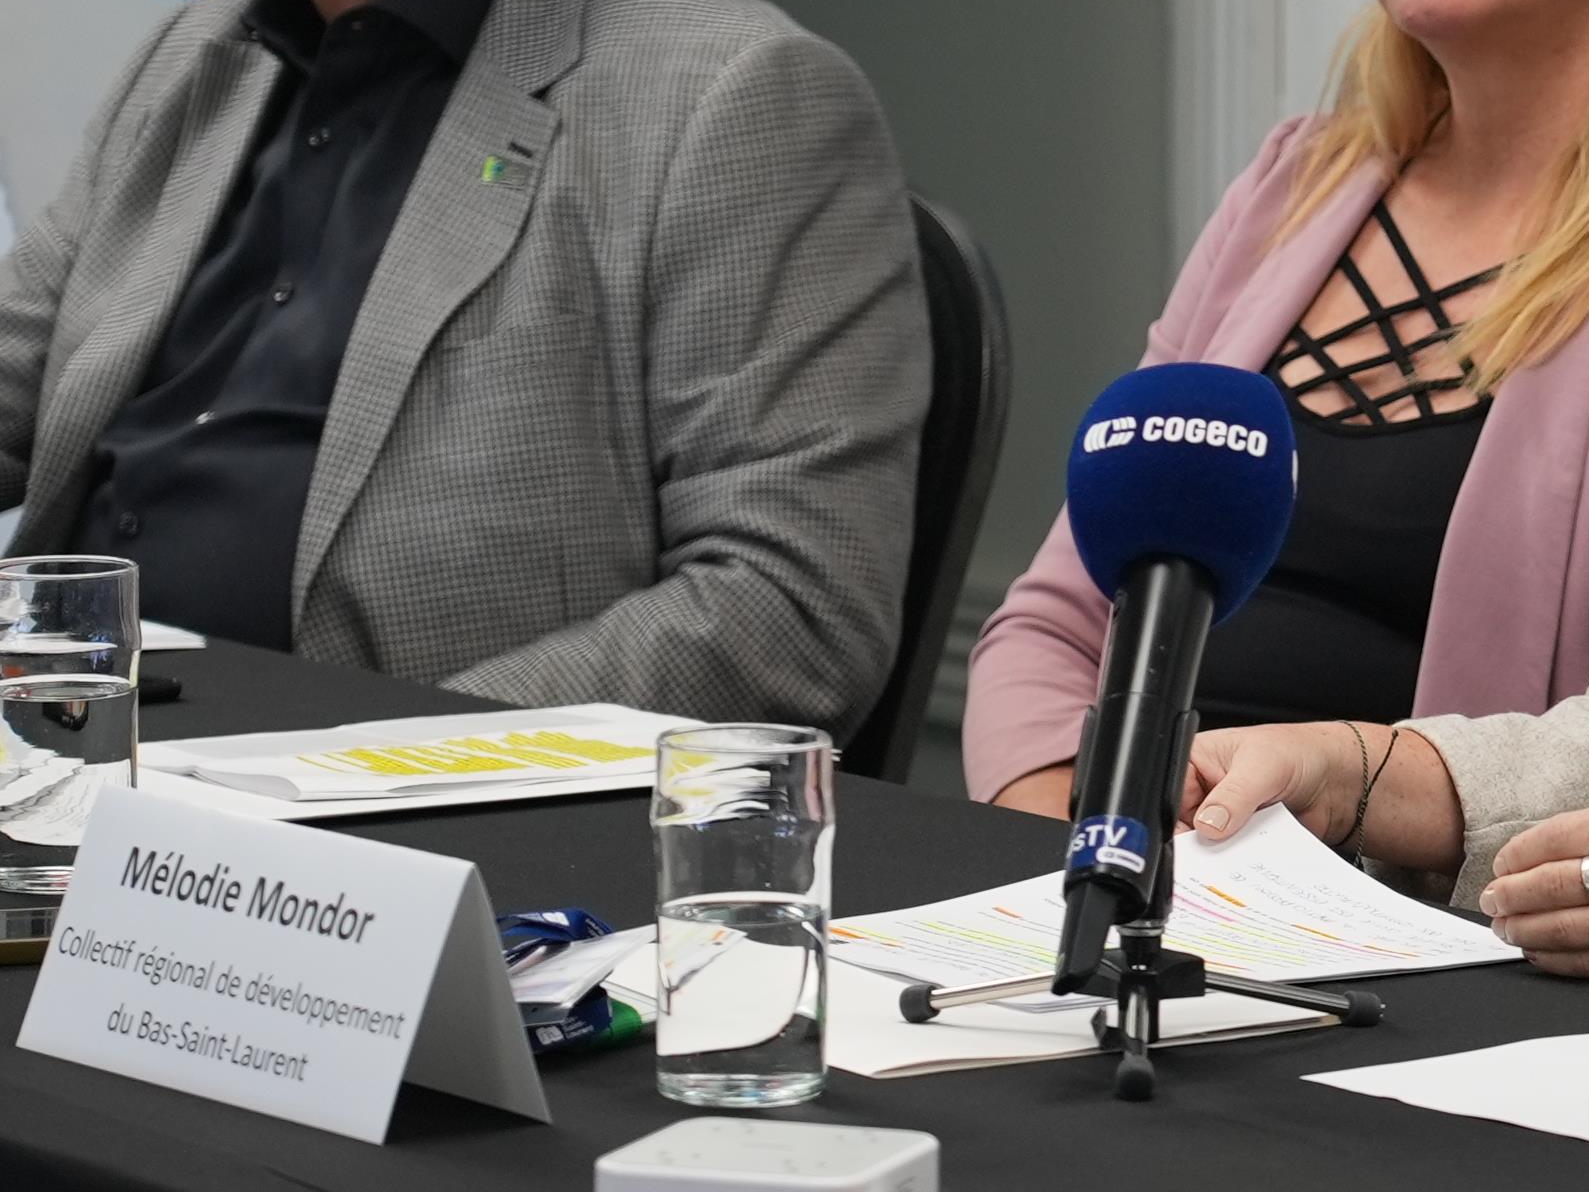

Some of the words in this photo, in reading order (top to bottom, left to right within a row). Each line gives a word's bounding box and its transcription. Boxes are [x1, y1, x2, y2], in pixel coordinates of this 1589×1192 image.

[121, 846, 242, 913] Mélodie
[246, 876, 376, 944] Mondor
[58, 925, 137, 970] Collectif
[133, 944, 216, 992] régional
[214, 964, 241, 999] de
[245, 972, 406, 1040] développement
[107, 1003, 134, 1036] du
[137, 1009, 310, 1082] Bas-Saint-Laurent
